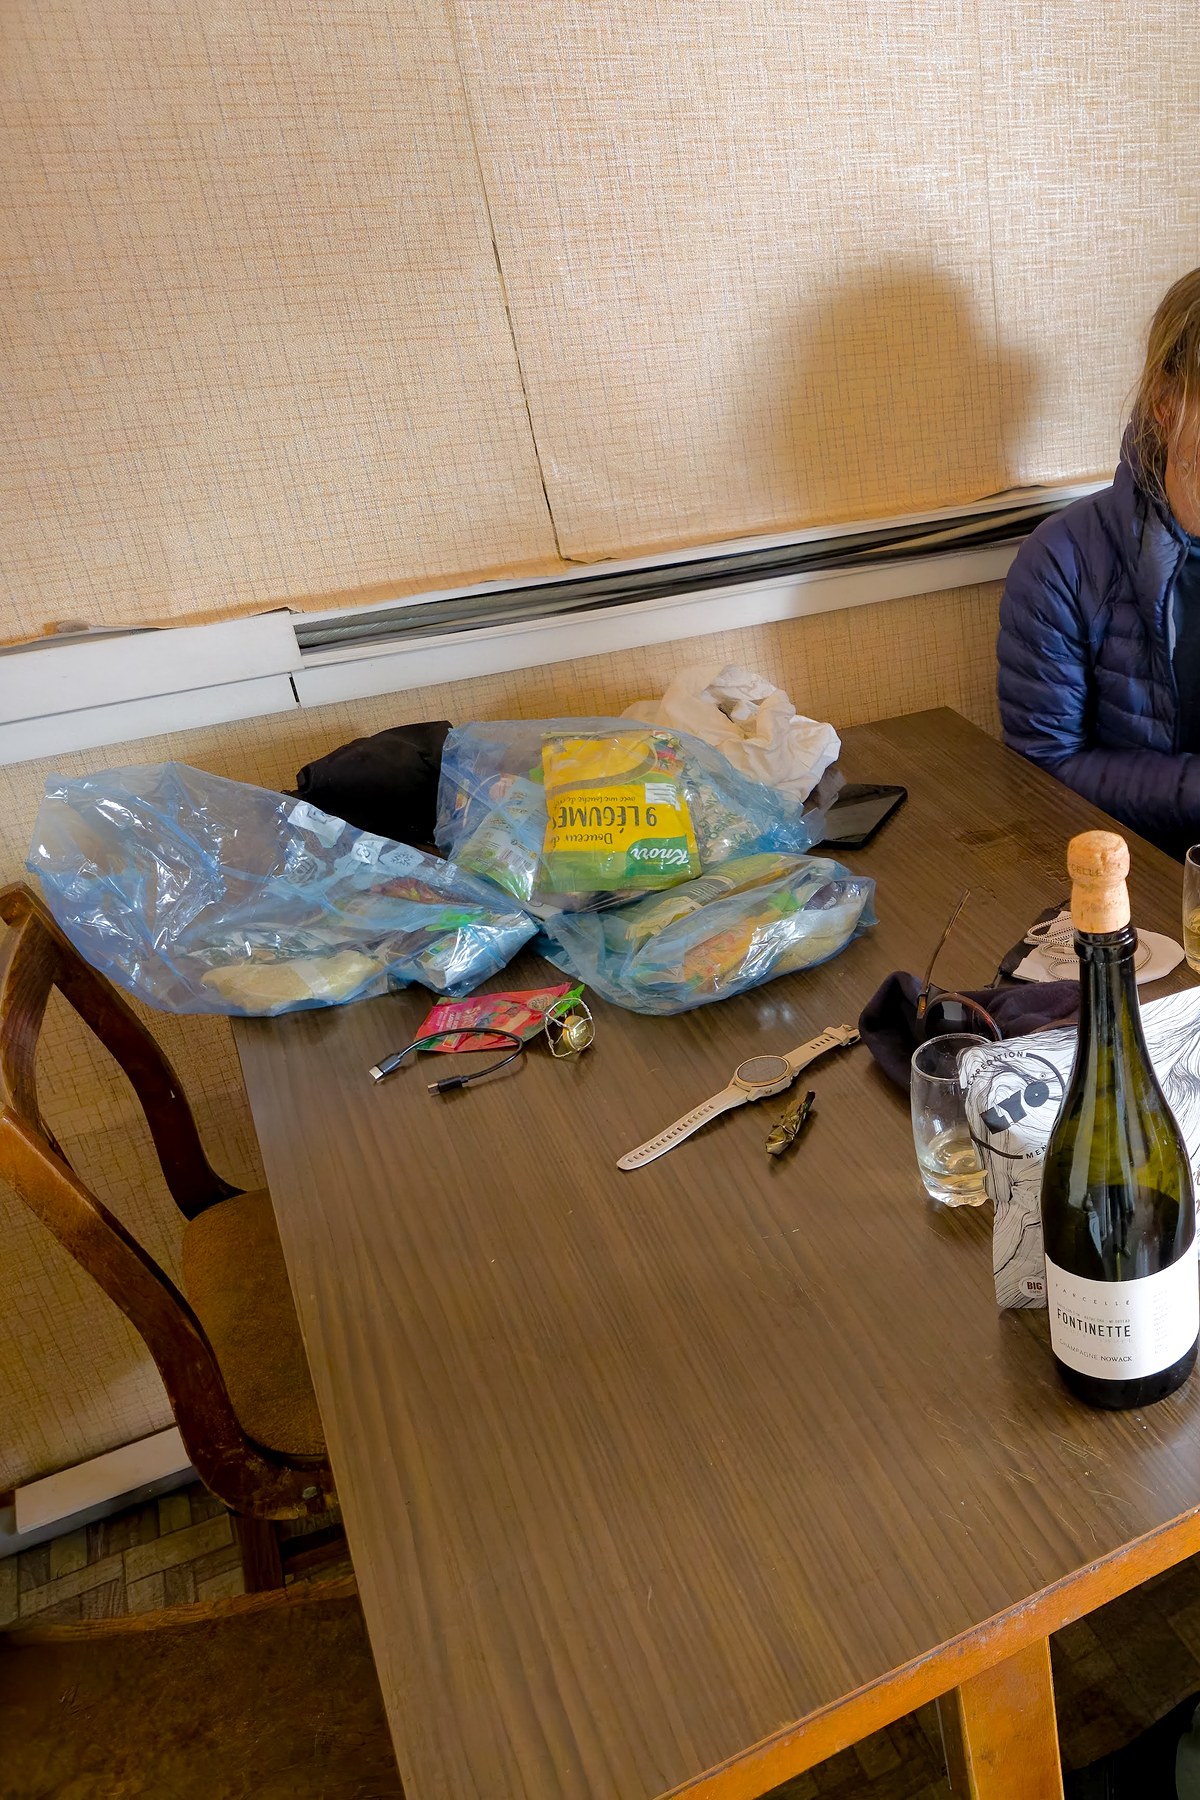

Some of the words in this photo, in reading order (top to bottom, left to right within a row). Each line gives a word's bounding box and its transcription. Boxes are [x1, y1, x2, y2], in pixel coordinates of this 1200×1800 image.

[646, 807, 658, 827] 9
[630, 847, 690, 865] Knorr
[966, 1050, 1024, 1087] EXPEDITION
[980, 1081, 1050, 1135] LYO
[1027, 1281, 1043, 1290] BIG
[1056, 1308, 1131, 1338] FONTINETTE
[1059, 1338, 1098, 1361] CHAMPAGNE
[1100, 1355, 1133, 1363] NOWACK
